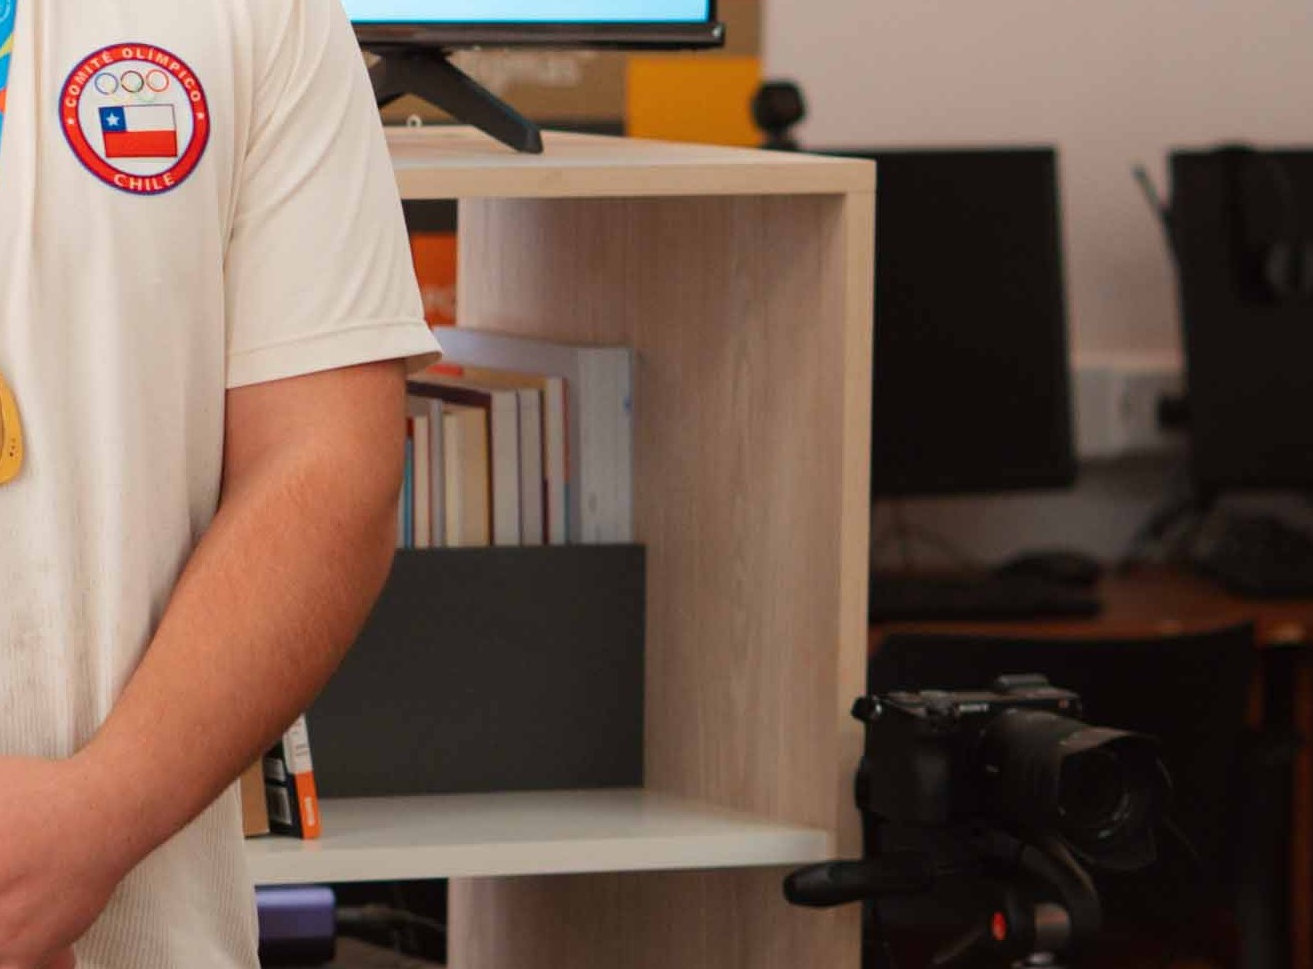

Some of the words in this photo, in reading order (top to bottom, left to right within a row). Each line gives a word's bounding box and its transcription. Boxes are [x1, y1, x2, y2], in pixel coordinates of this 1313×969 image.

[65, 50, 114, 108] COMITÉ
[121, 47, 202, 102] OLÍMPICO
[113, 172, 175, 191] CHILE
